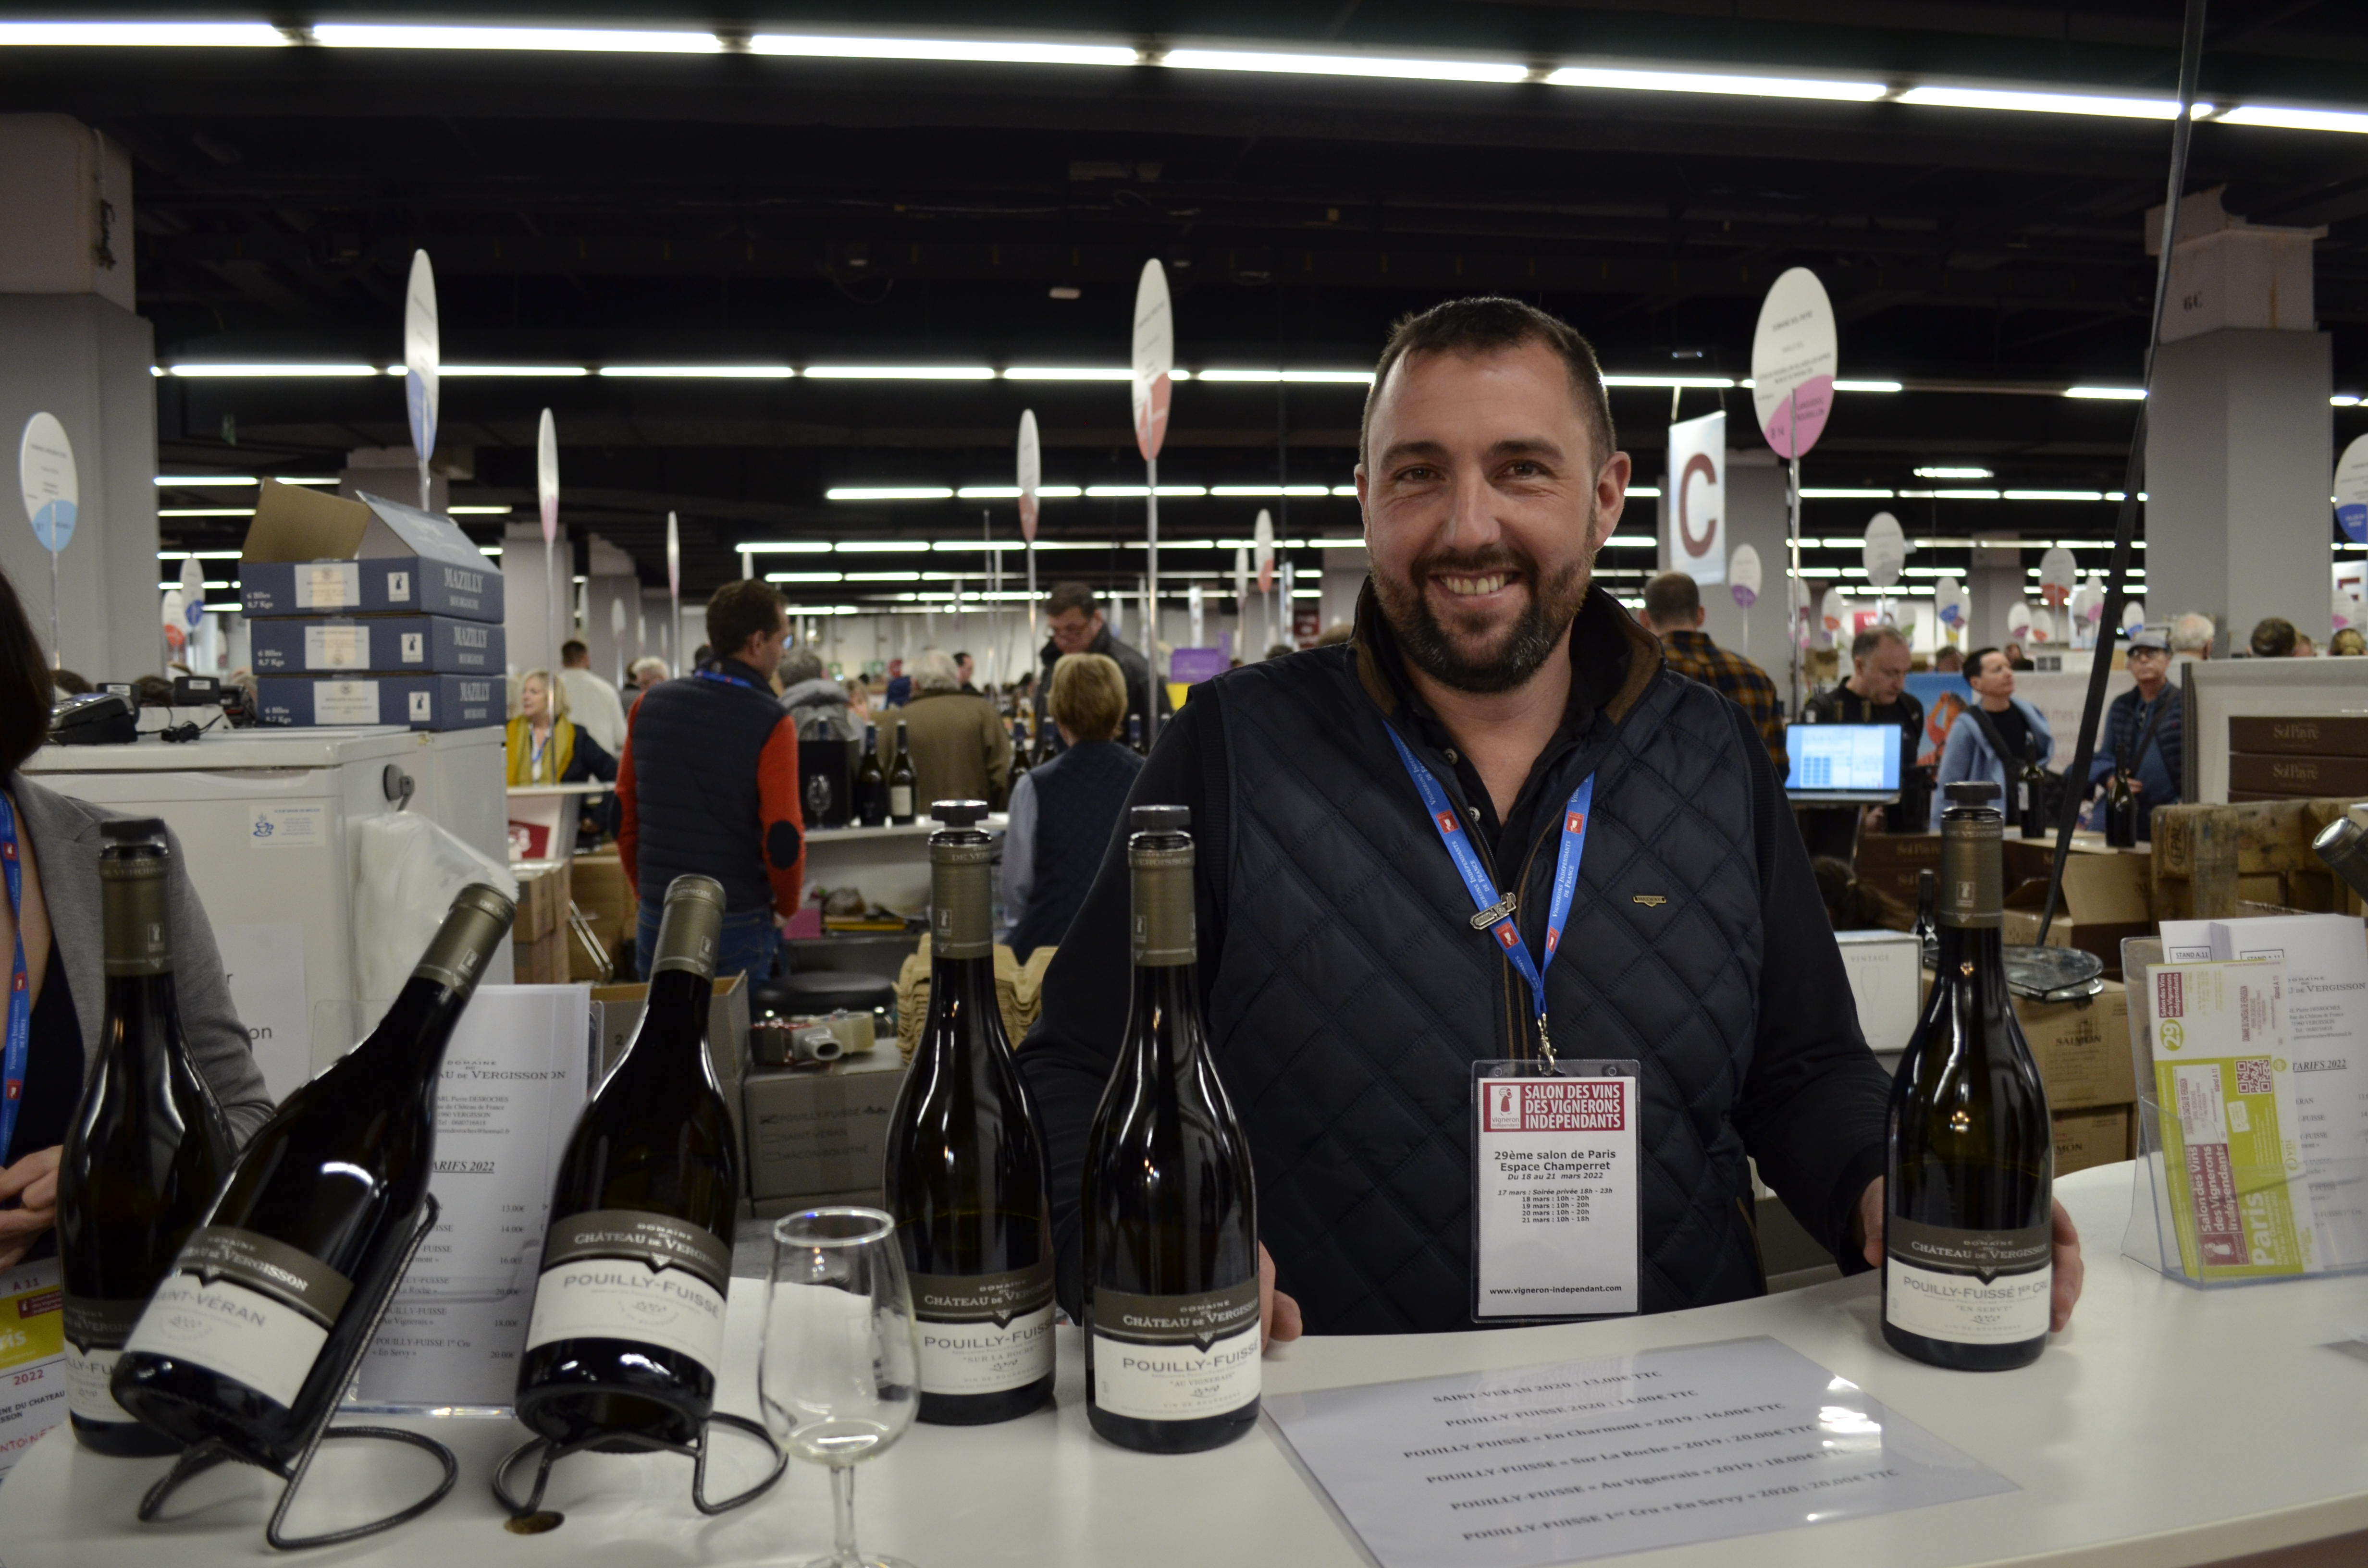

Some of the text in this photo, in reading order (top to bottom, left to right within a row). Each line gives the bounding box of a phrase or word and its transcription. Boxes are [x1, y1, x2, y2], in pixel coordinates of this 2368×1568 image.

[1679, 453, 1717, 558] C
[444, 567, 483, 594] MAZILLY
[454, 626, 488, 648] MAZILLY
[460, 682, 491, 702] MAZILLY
[1451, 840, 1476, 883] INDÉPENDANTS
[1552, 840, 1571, 918] VIGNERONS INDÉPENDANTS
[1565, 865, 1575, 888] FRANCE
[1850, 954, 1890, 962] VINTAGE
[2306, 982, 2367, 992] VERGISSON
[2056, 1034, 2102, 1046] SALMON
[2162, 1024, 2182, 1047] 29
[2328, 1059, 2347, 1070] 2022
[472, 1070, 548, 1080] VERGISSON
[1524, 1084, 1621, 1100] SALON DES VINS
[1525, 1099, 1621, 1114] DES VIGNERONS
[1525, 1112, 1621, 1129] INDÉPENDANTS
[1494, 1150, 1616, 1161] 29ème salon de Paris
[469, 1161, 495, 1173] 2022
[1500, 1161, 1611, 1173] Espace Champerret
[1556, 1188, 1578, 1196] privée
[2189, 1146, 2212, 1232] Salon des Vins
[2203, 1145, 2225, 1232] des Vignerons
[574, 1230, 646, 1245] CHÂTEAU
[2242, 1192, 2276, 1265] Paris
[1910, 1240, 1971, 1259] CHÂTEAU
[1990, 1243, 2047, 1260] VERGISSON
[223, 1248, 309, 1292] VERGISSON
[13, 1277, 39, 1292] A 11
[1489, 1285, 1622, 1296] www.vigneron-independant.com
[1903, 1275, 2015, 1299] POUILLY-FUISSÉ
[924, 1295, 988, 1307] CHÂTEAU
[1122, 1314, 1190, 1328] CHÂTEAU
[13, 1369, 45, 1386] 2022
[1433, 1371, 1663, 1403] SAINT-VERAN 2020 TTC
[15, 1390, 66, 1411] DU CHATEAU
[1444, 1390, 1699, 1427] POUILLY-FUISSE 2020 TTC
[1402, 1436, 1531, 1458] POUILLY-FUISSE
[1543, 1432, 1565, 1441] En
[1566, 1422, 1641, 1438] Charmont
[1655, 1416, 1693, 1426] 2019
[1753, 1403, 1786, 1413] TTC
[1426, 1423, 1817, 1484] POUILLY-FUISSE Sur La Roche 2019 TTC
[1450, 1486, 1587, 1510] POUILLY-FUISSE
[1600, 1481, 1622, 1490] Au
[1624, 1470, 1700, 1487] Vignerais
[1714, 1461, 1753, 1474] 2019
[1461, 1469, 1901, 1541] POUILLY-FUISSE 1er Cru En Servy 2020 TTC
